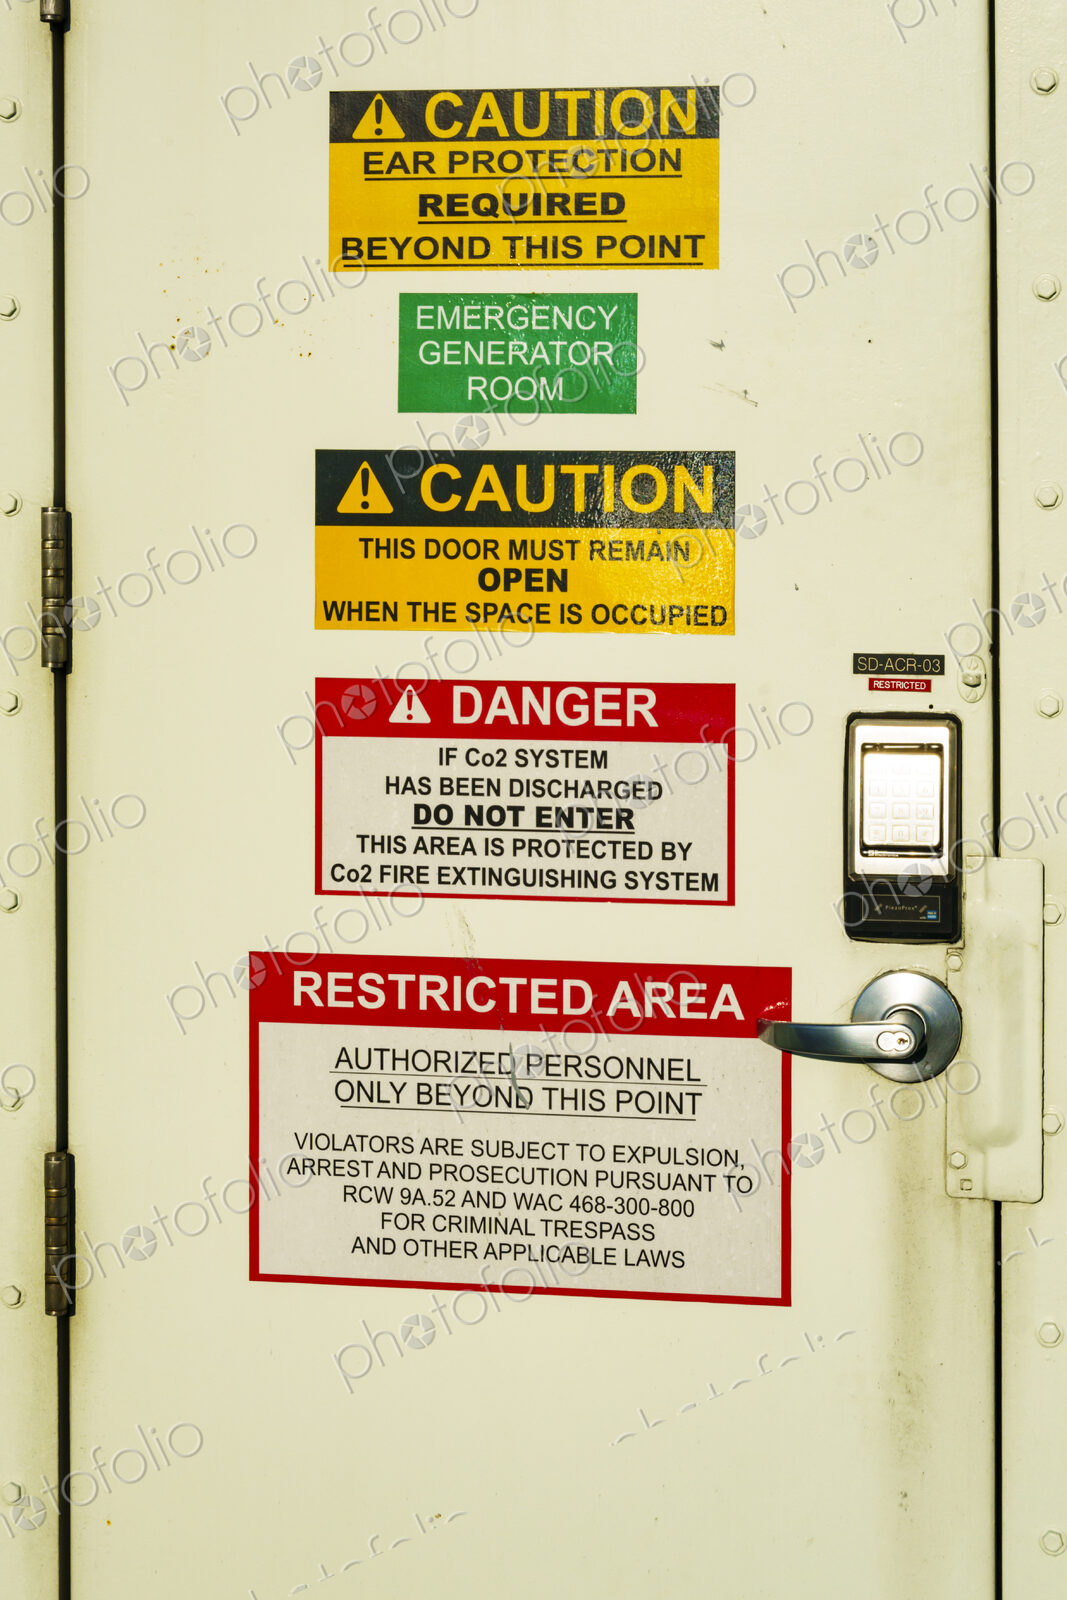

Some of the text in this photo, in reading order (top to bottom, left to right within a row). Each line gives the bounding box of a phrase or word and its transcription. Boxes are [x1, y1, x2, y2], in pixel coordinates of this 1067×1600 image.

[424, 88, 698, 139] CAUTION
[363, 147, 682, 175] EAR PROTECTION
[418, 191, 626, 219] REQUIRED
[341, 234, 706, 261] BEYOND THIS POINT
[416, 303, 619, 332] EMERGENCY
[418, 340, 617, 368] GENERATOR
[467, 375, 564, 402] ROOM
[419, 463, 714, 514] CAUTION
[358, 537, 690, 562] THIS DOOR MUST REMAIN
[477, 566, 569, 593] OPEN
[322, 600, 728, 627] WHEN THE SPACE IS OCCUPIED
[857, 656, 941, 673] SD-ACR-03
[873, 680, 927, 690] RESTRICTED
[452, 685, 659, 728] DANGER
[438, 747, 608, 770] IF Co2 SYSTEM
[385, 775, 663, 801] HAS BEEN DISCHARGED
[413, 803, 635, 830] DO NOT ENTER
[355, 834, 693, 862] THIS AREA IS PROTECTED BY
[330, 863, 719, 892] Co2 FIRE EXTINGUISHING SYSTEM
[293, 970, 745, 1021] RESTRICTED AREA
[334, 1046, 701, 1082] AUTHORIZED PERSONNEL
[334, 1079, 703, 1116] ONLY BEYOND THIS POINT
[293, 1132, 745, 1171] VIOLATORS ARE SUBJECT TO EXPULSION,
[286, 1157, 753, 1194] ARREST AND PROSECUTION PURSUANT TO
[343, 1184, 695, 1218] RCW 9A.52 AND WAC 468-300-800
[381, 1211, 656, 1242] FOR CRIMINAL TRESPASS
[351, 1236, 685, 1269] AND OTHER APPLICABLE LAWS
